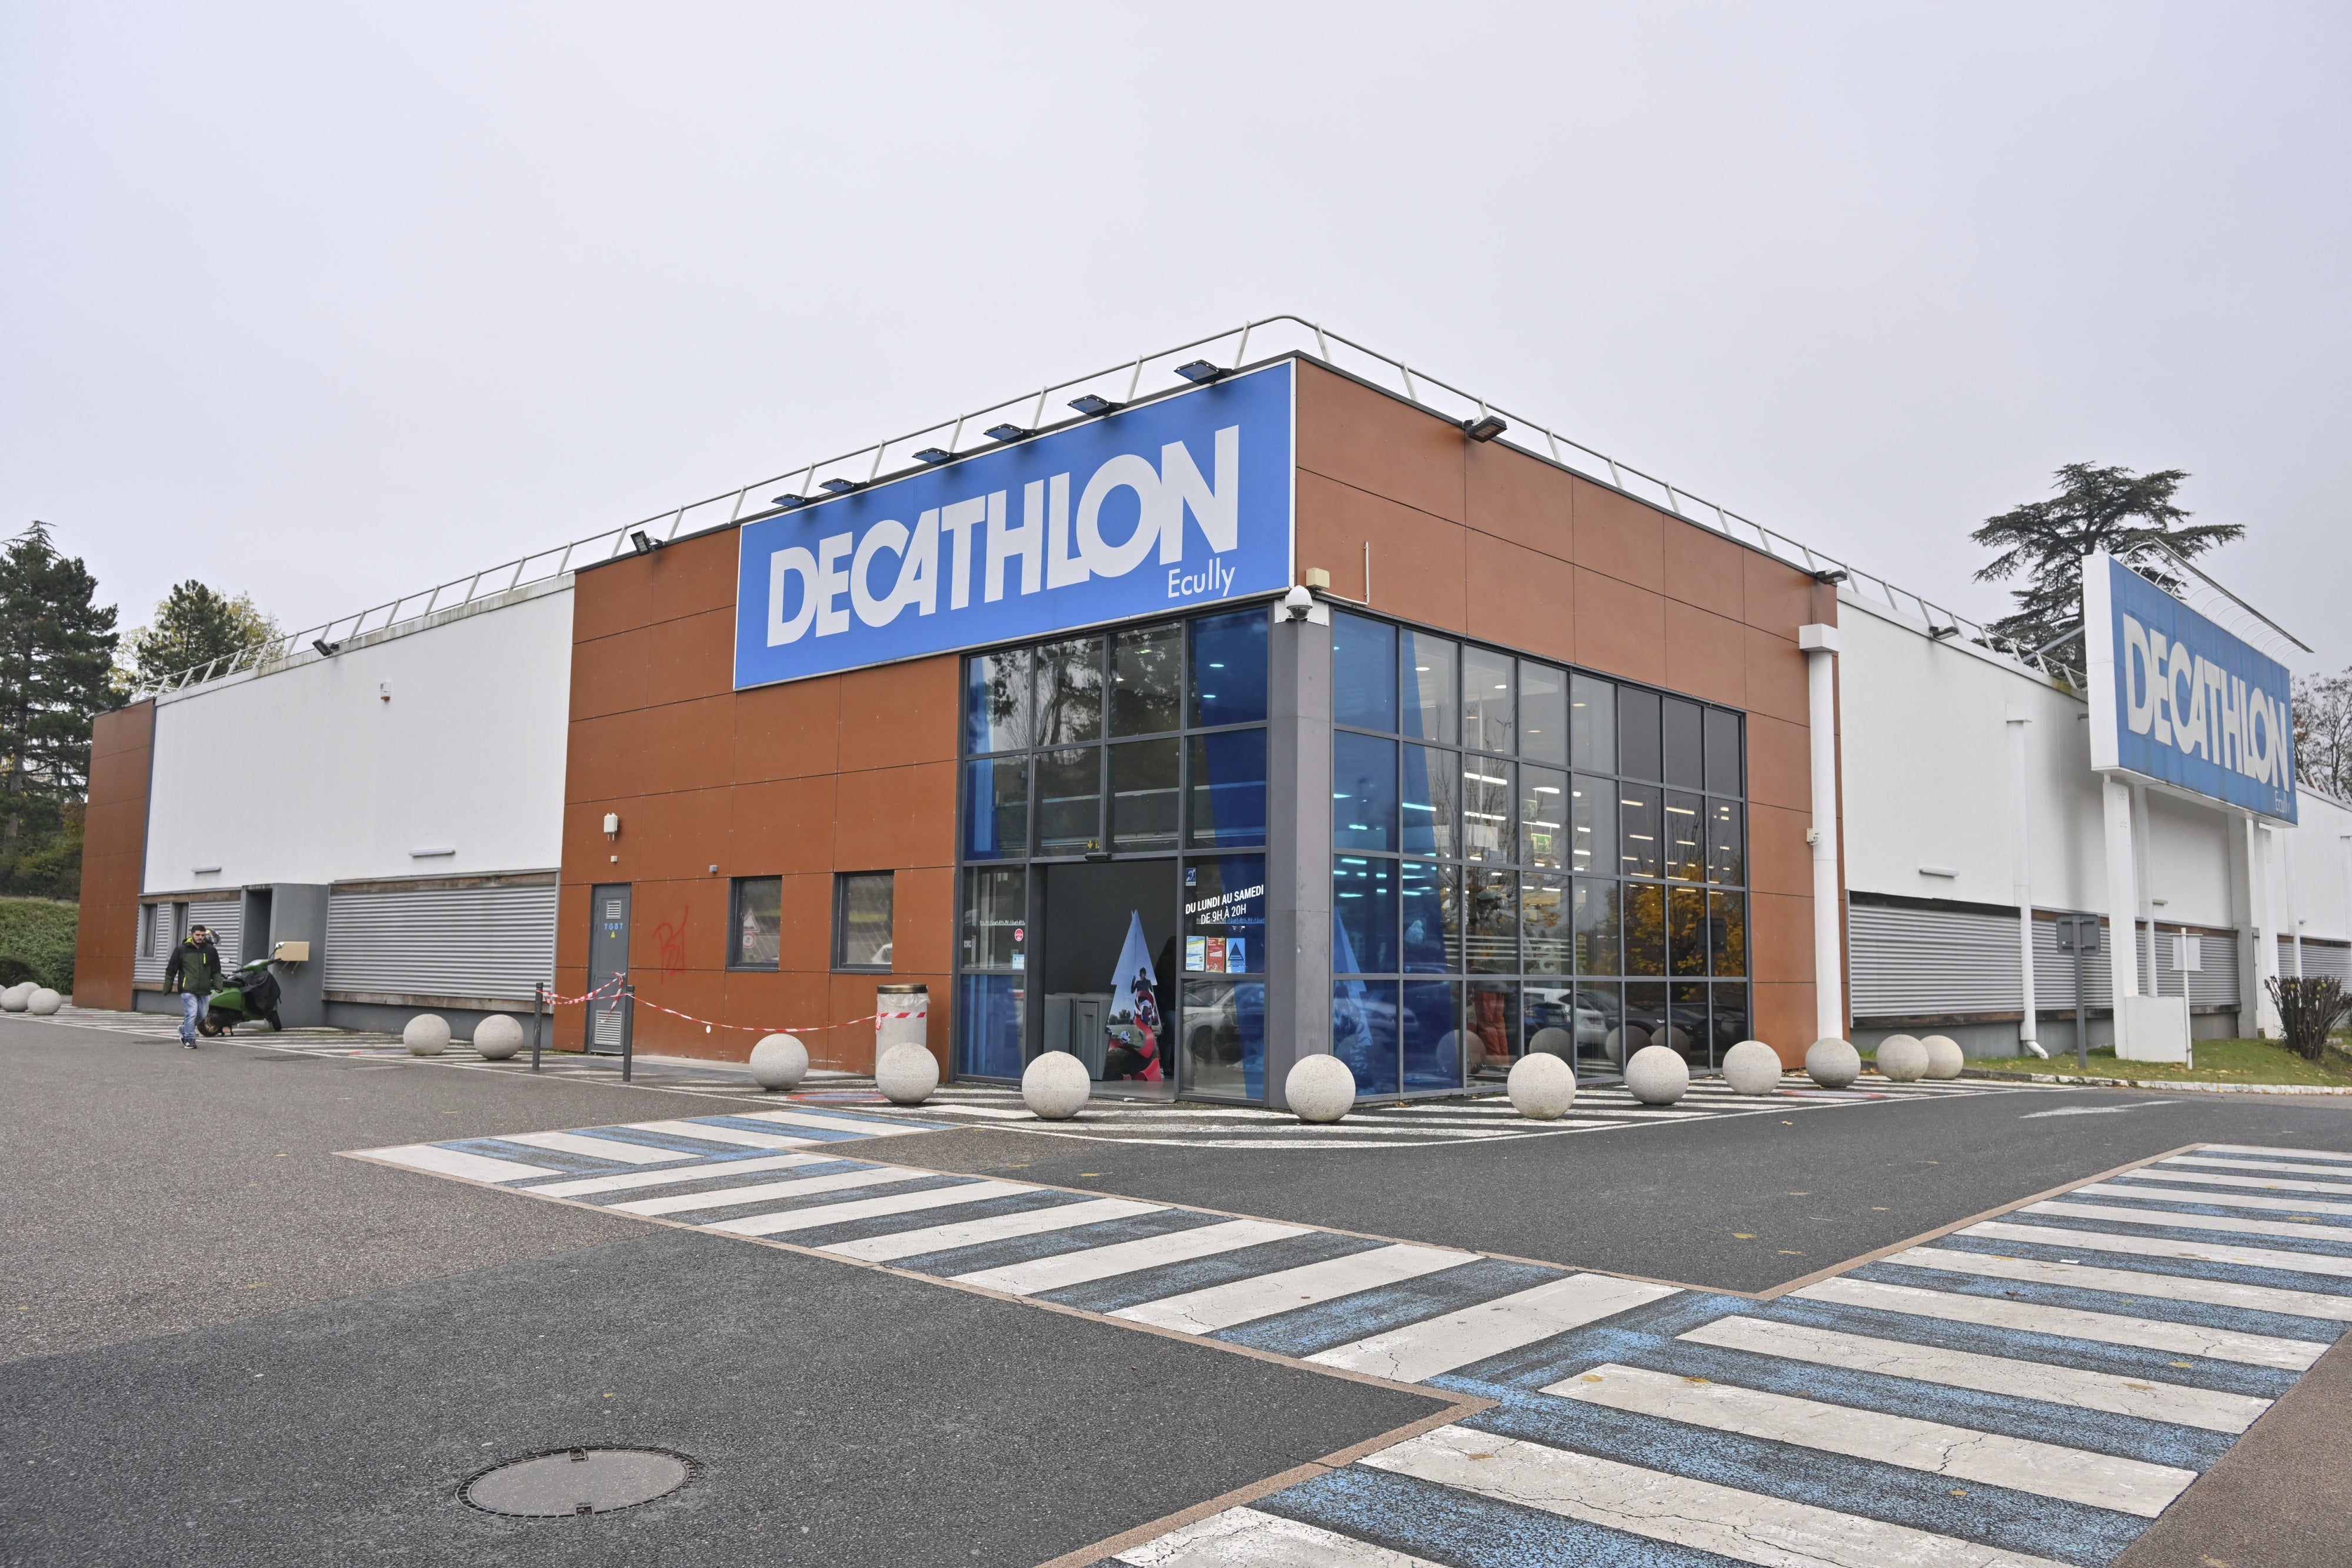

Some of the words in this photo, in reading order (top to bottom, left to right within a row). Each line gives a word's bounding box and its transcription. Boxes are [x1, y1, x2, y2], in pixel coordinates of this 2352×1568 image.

[767, 425, 1239, 647] DECATHLON
[1168, 558, 1236, 599] Ecully
[2123, 613, 2290, 792] DECATHLON
[1185, 902, 1196, 915] DU
[1197, 895, 1220, 911] LUNDI
[1222, 893, 1232, 905] AU
[1234, 884, 1264, 902] SAMEDI
[1201, 912, 1210, 925] DE
[1212, 909, 1222, 922] 9H
[1224, 906, 1229, 919] À
[1231, 903, 1246, 917] 20H
